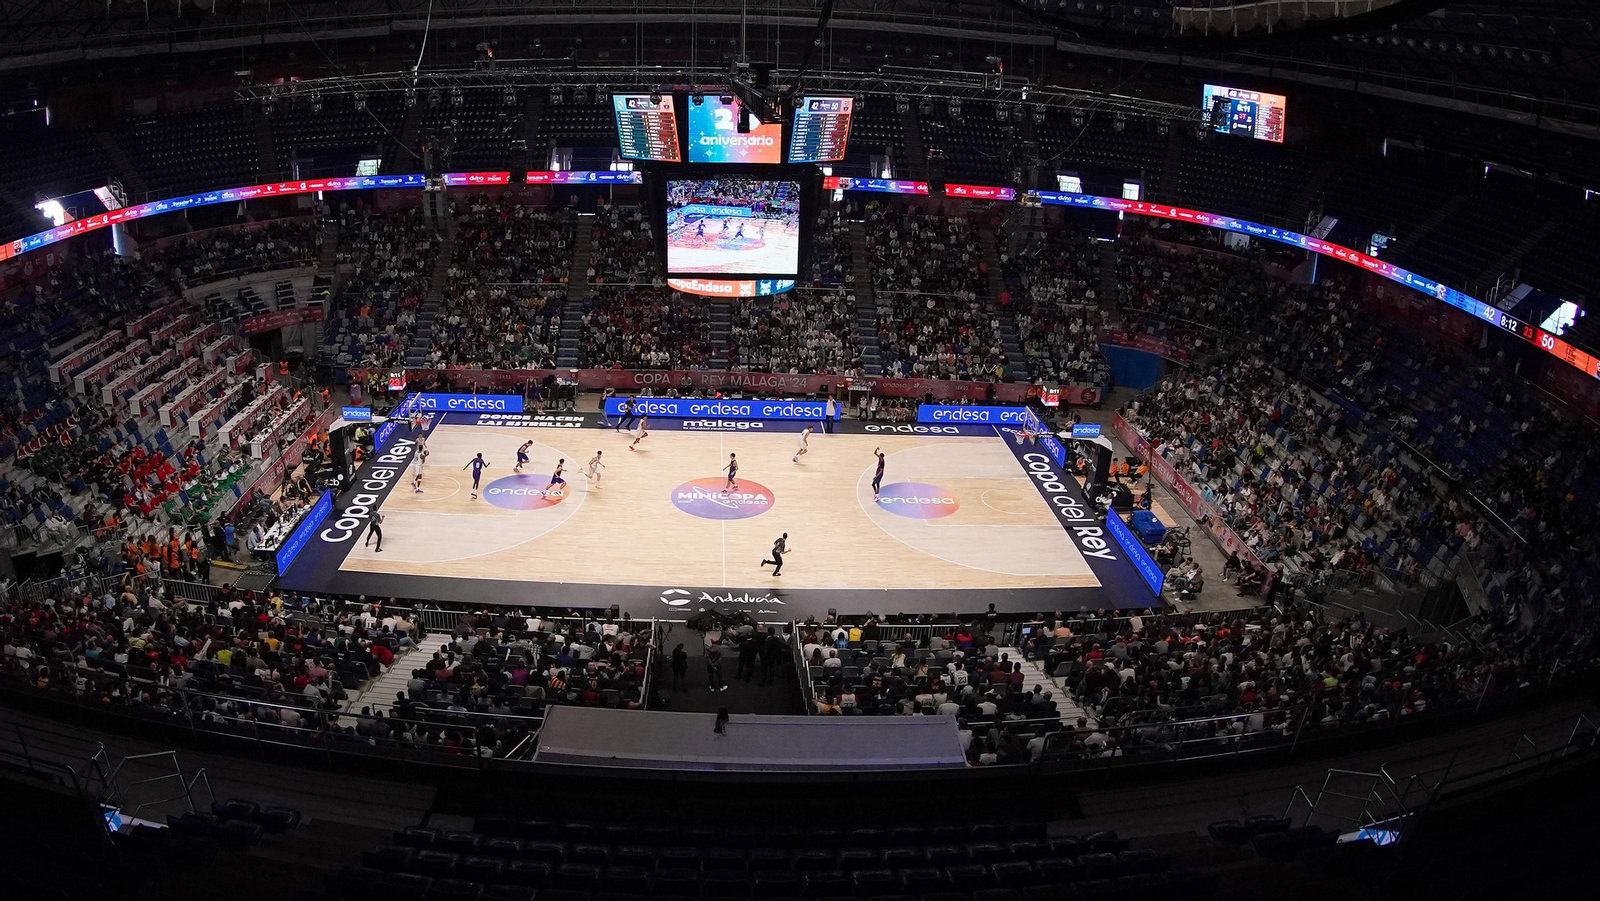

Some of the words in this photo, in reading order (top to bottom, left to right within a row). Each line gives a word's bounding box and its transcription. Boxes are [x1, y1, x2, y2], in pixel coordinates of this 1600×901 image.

[701, 134, 774, 146] aniversario
[711, 205, 742, 216] endesa
[1483, 306, 1496, 321] 42
[1500, 315, 1517, 332] 8:12
[1523, 326, 1533, 339] 23
[1541, 334, 1554, 350] 50
[389, 378, 400, 386] 23
[634, 373, 671, 384] COPA
[701, 374, 726, 385] REY
[448, 396, 505, 409] endesa
[1047, 394, 1058, 402] 23
[343, 409, 371, 417] endesa
[690, 401, 751, 416] endesa
[763, 403, 823, 417] endesa
[933, 407, 989, 421] endesa
[865, 424, 960, 434] endesa
[1073, 427, 1100, 435] endesa
[377, 438, 416, 464] Rey
[362, 466, 399, 491] del
[1022, 453, 1067, 493] Copa
[880, 495, 956, 505] endesa
[1053, 496, 1095, 522] del
[320, 493, 379, 543] Copa
[1073, 526, 1118, 561] Rey
[698, 591, 786, 605] Andalucía
